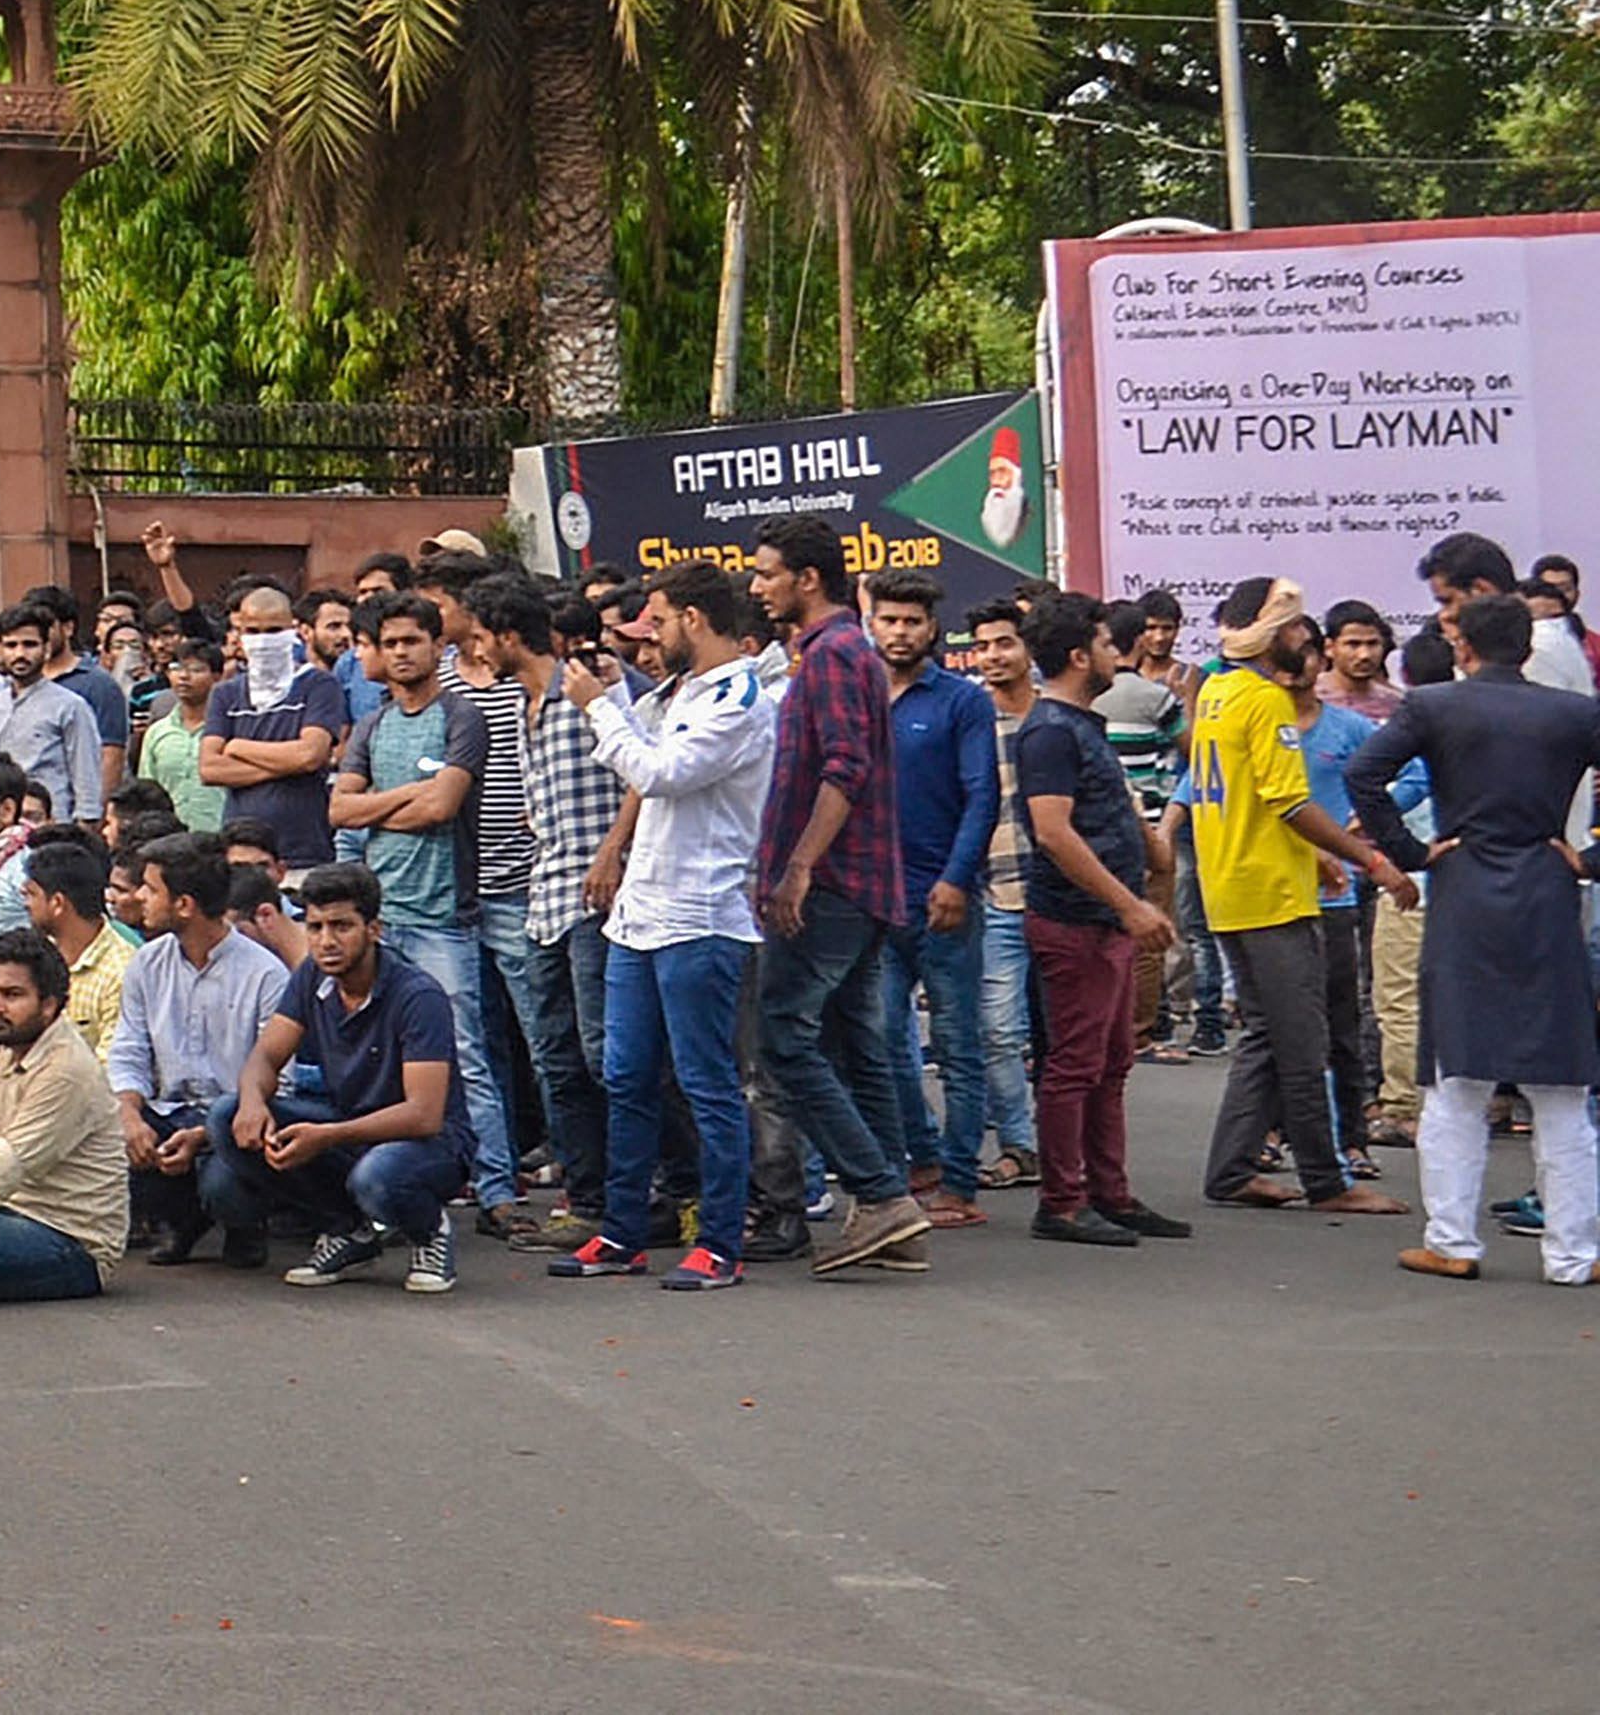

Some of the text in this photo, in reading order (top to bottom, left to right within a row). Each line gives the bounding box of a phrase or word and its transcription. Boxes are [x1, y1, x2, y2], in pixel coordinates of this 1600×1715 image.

[1113, 261, 1464, 297] Club For Short Evening Courses
[1113, 303, 1177, 323] Cultural
[1185, 301, 1257, 320] Education
[1327, 296, 1368, 314] AMU
[1116, 371, 1512, 411] Organising a One-Day Workshop on
[1235, 414, 1317, 453] FOR
[673, 436, 882, 494] AFTAB HALL
[704, 490, 856, 522] Aligarh Muslim University
[1173, 491, 1231, 514] concept
[1236, 491, 1253, 509] of
[1260, 489, 1319, 509] criminal
[1326, 490, 1377, 511] justice
[1383, 490, 1440, 511] system
[1445, 487, 1460, 503] in
[1177, 522, 1204, 536] are
[1209, 517, 1243, 535] Civil
[1247, 519, 1300, 542] rights
[1305, 518, 1333, 534] and
[1395, 511, 1461, 538] rights?
[889, 537, 941, 569] 2018
